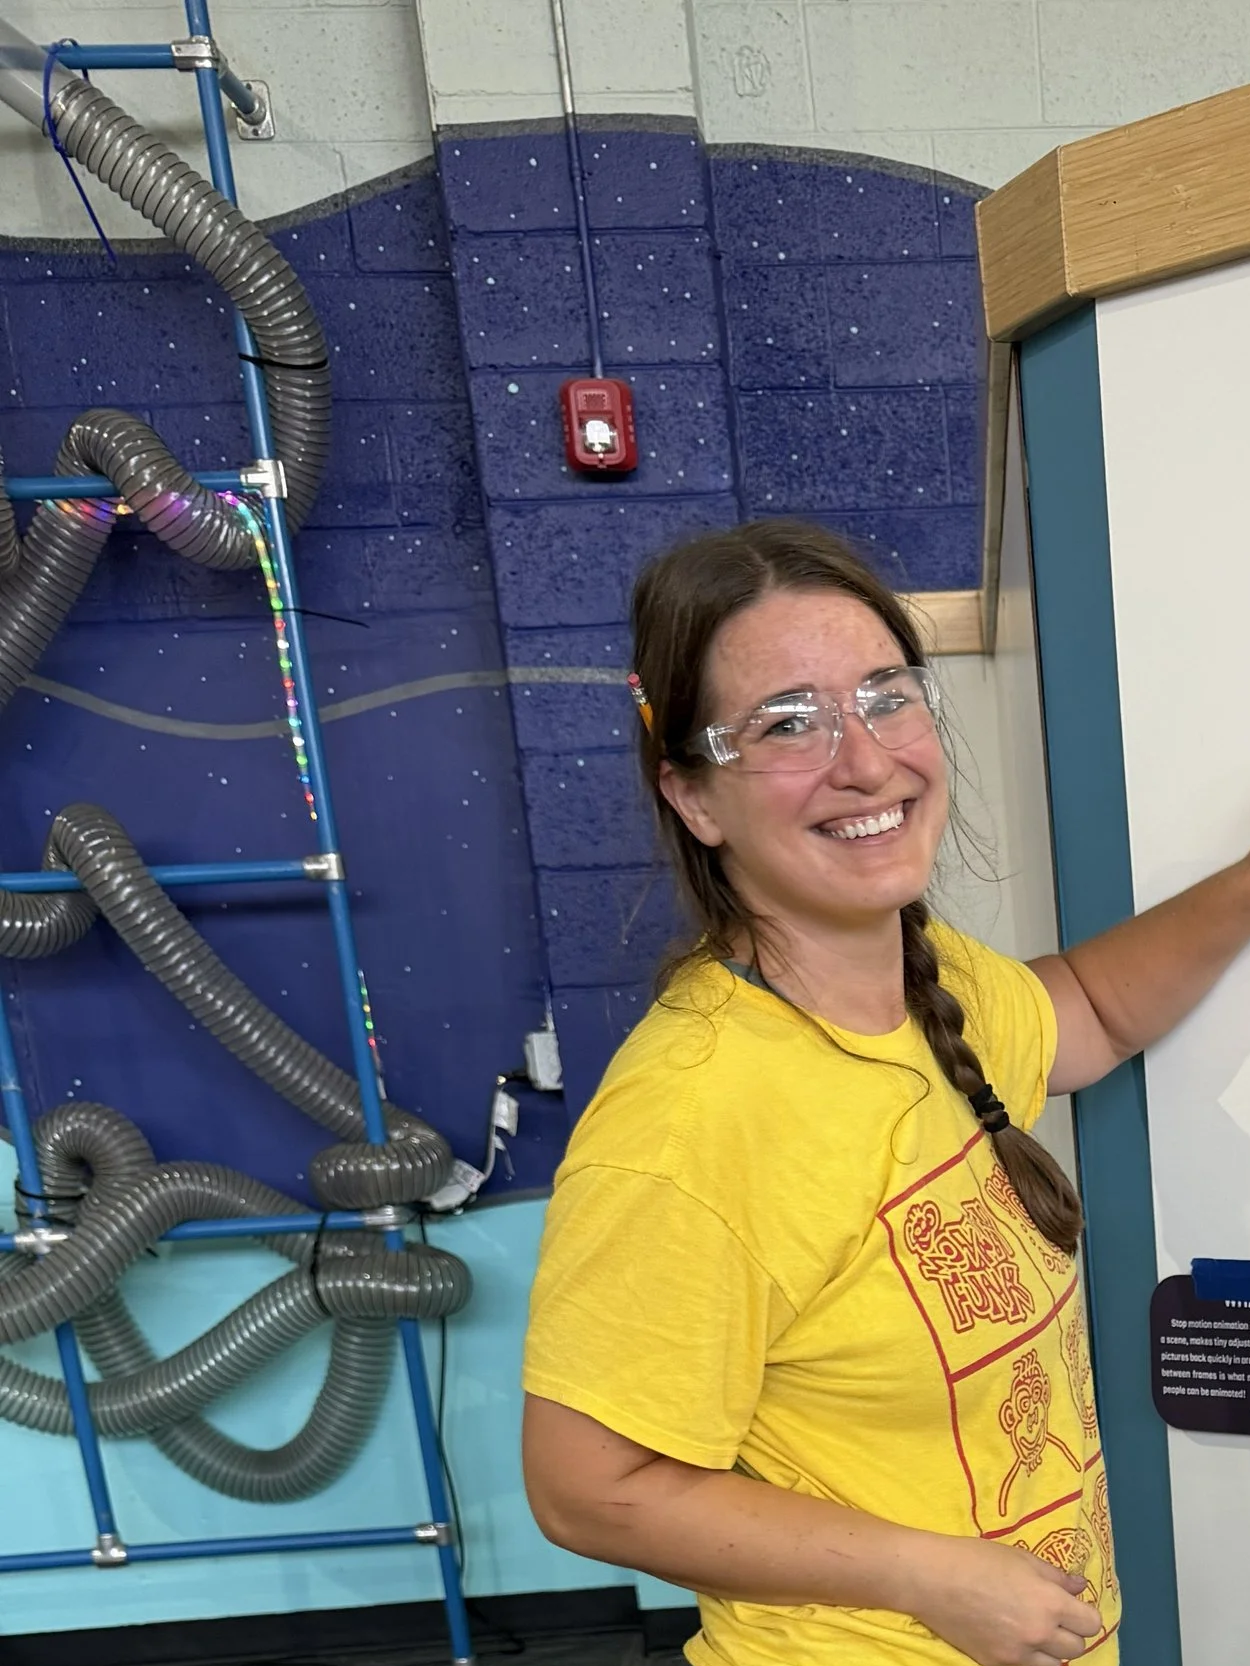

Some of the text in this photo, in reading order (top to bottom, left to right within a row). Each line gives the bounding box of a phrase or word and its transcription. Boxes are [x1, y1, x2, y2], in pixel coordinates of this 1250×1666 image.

[1171, 1318, 1187, 1329] Stop
[1188, 1319, 1212, 1328] motion
[1213, 1320, 1248, 1329] animation
